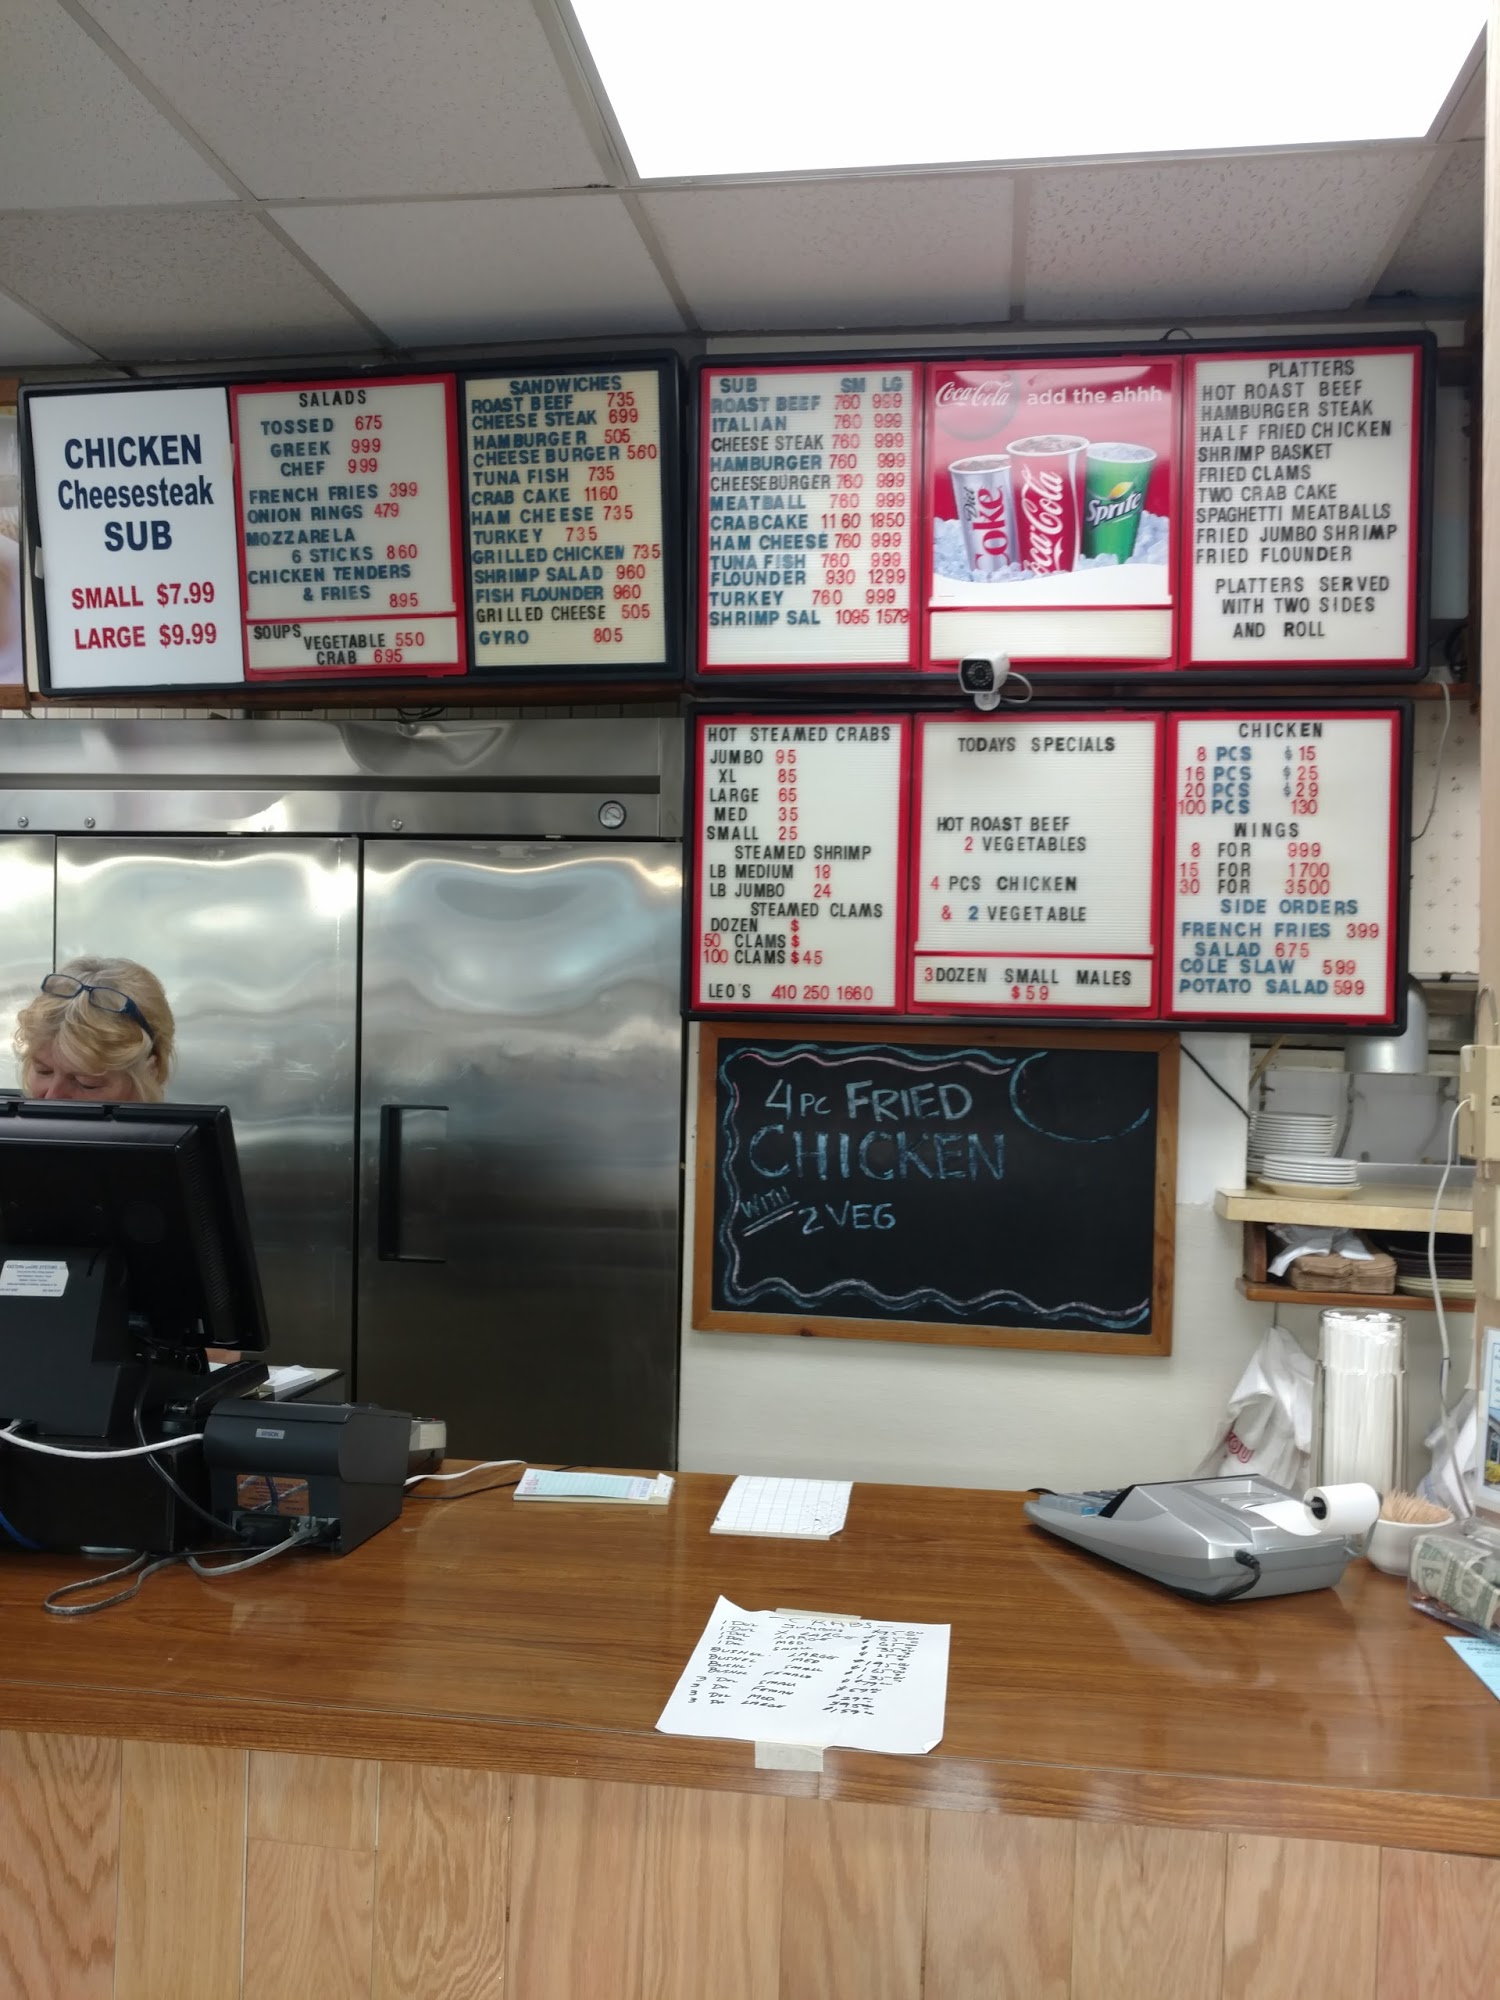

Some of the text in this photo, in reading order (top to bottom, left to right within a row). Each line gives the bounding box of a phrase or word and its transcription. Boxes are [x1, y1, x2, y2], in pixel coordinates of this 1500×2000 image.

[1268, 361, 1355, 378] PLATTERS
[510, 376, 622, 395] SANDWICHES
[721, 378, 757, 393] SUB
[1202, 380, 1363, 401] HOT ROAST BEEF
[300, 390, 367, 407] SALADS
[1027, 390, 1066, 406] add
[1074, 388, 1106, 404] the
[1112, 386, 1162, 403] ahhh
[473, 408, 638, 430] CHEESE STEAK 699
[1201, 401, 1373, 421] HAMBURGER STEAK
[261, 415, 382, 435] TOSSED 675
[65, 434, 202, 469] CHICKEN
[281, 458, 377, 477] CHEF 999
[711, 455, 822, 471] HAMBURGER
[830, 454, 857, 469] 760
[473, 466, 614, 485] TUNA FISH 735
[1199, 465, 1311, 482] FRIED CLAMS
[58, 476, 214, 510] Cheesesteak
[249, 482, 417, 504] FRENCH FRIES 399
[472, 486, 618, 506] CRAB CAKE 1160
[1199, 484, 1337, 502] TWO CRAB CAKE
[248, 503, 399, 523] ONION RINGS 479
[1086, 490, 1142, 527] Sprite
[871, 512, 905, 527] 1850
[105, 520, 172, 551] SUB
[473, 527, 597, 545] TURKEY 735
[711, 533, 861, 550] HAM CHEESE 760
[1196, 546, 1352, 564] FRIED FLOUNDER
[248, 564, 411, 584] CHICKEN TENDERS
[474, 564, 645, 584] SHRIMP SALAD 960
[711, 569, 905, 586] FLOUNDER 930 1299
[1215, 576, 1389, 594] PLATTERS SERVED
[72, 582, 215, 610] SMALL $7.99
[709, 590, 896, 607] TURKEY 760 999
[477, 604, 650, 623] GRILLED CHEESE 505
[1222, 597, 1375, 614] WITH TWO SIDES
[74, 622, 216, 650] LARGE $9.99
[254, 624, 301, 639] SOUPS
[480, 628, 623, 645] GYRO 805
[1233, 622, 1325, 639] AND ROLL
[304, 632, 424, 649] VEGETABLE 550
[317, 649, 402, 665] CRAB 695
[708, 726, 890, 742] HOT STEAMED CRABS
[1239, 722, 1323, 738] CHICKEN
[958, 737, 1115, 752] TODAYS SPECIALS
[710, 750, 796, 764] JUMBO 95
[710, 788, 796, 802] LARGE 65
[937, 817, 1070, 831] HOT ROAST BEEF
[1234, 823, 1299, 837] WINGS
[707, 826, 798, 840] SMALL 25
[965, 836, 1086, 851] 2 VEGETABLES
[1191, 844, 1320, 857] 8 FOR 999
[735, 846, 872, 860] STEAMED SHRIMP
[710, 864, 830, 878] LB MEDIUM 18
[1180, 863, 1330, 877] 15 FOR 1700
[931, 876, 1077, 891] 4 PCS CHICKEN
[1221, 900, 1358, 914] SIDE ORDERS
[1182, 922, 1379, 938] FRENCH FRIES 399
[1196, 943, 1309, 957] SALAD 675
[709, 984, 872, 1000] LEO'S 410 250 1660
[1180, 979, 1364, 994] POTATO SALAD 599
[765, 1079, 792, 1120] 4
[846, 1080, 973, 1121] FRIED
[749, 1125, 1005, 1180] CHICKEN
[799, 1203, 897, 1234] 2 VEG
